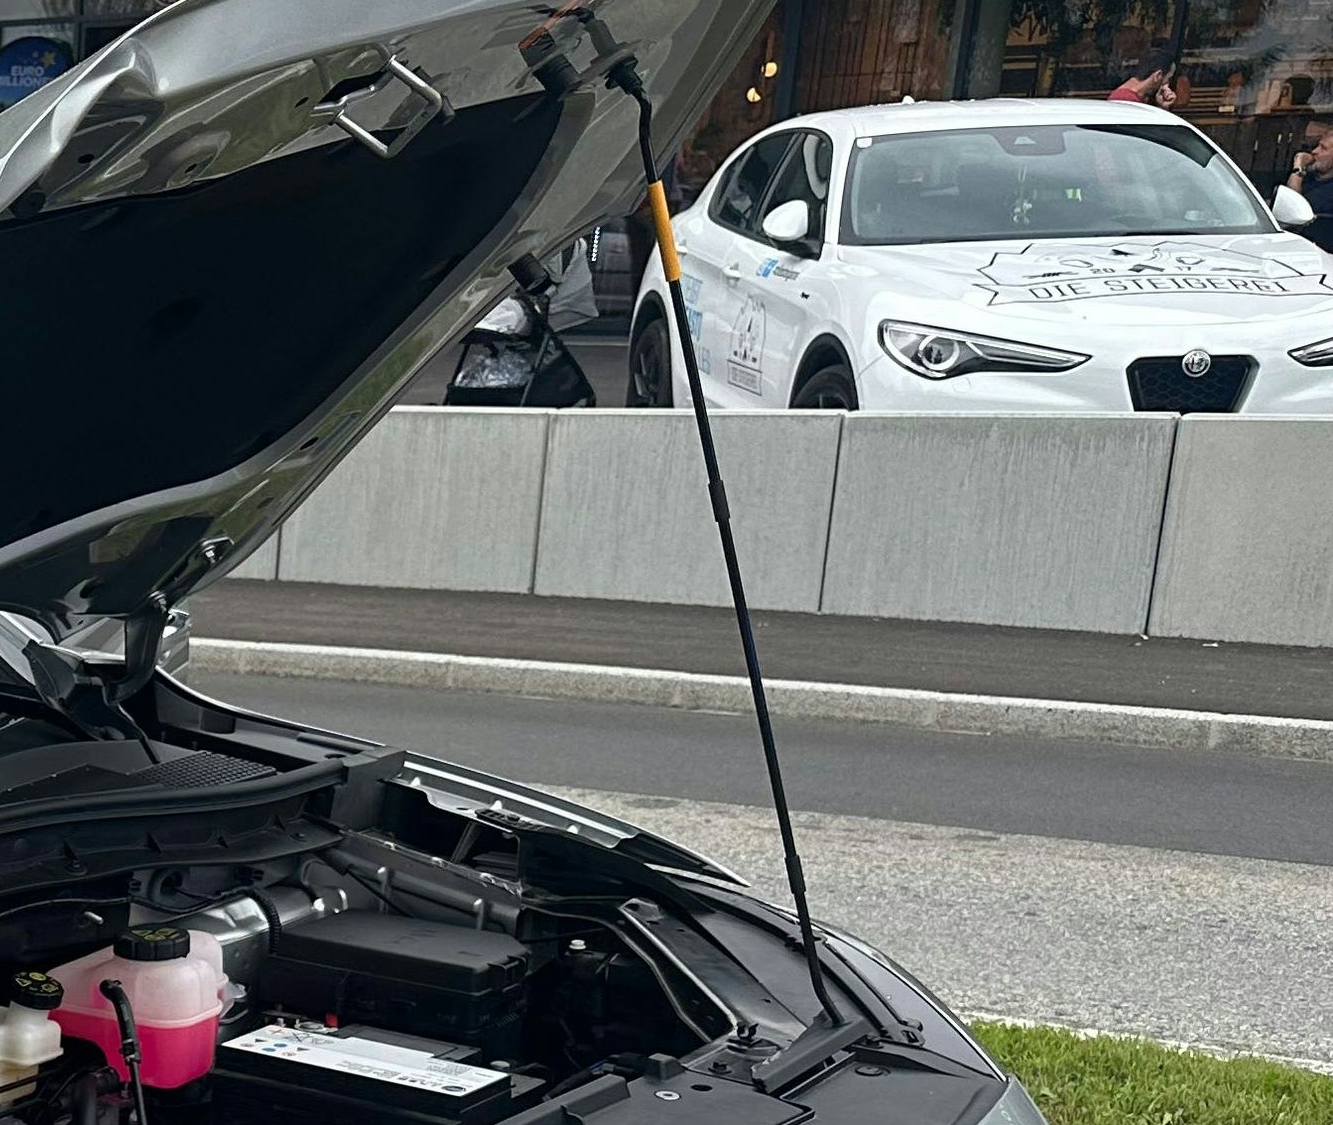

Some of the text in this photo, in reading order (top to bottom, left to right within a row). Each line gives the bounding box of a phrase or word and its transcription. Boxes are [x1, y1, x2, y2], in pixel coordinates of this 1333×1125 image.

[11, 66, 44, 76] EURO
[1028, 276, 1291, 300] DIE STEIGEREI
